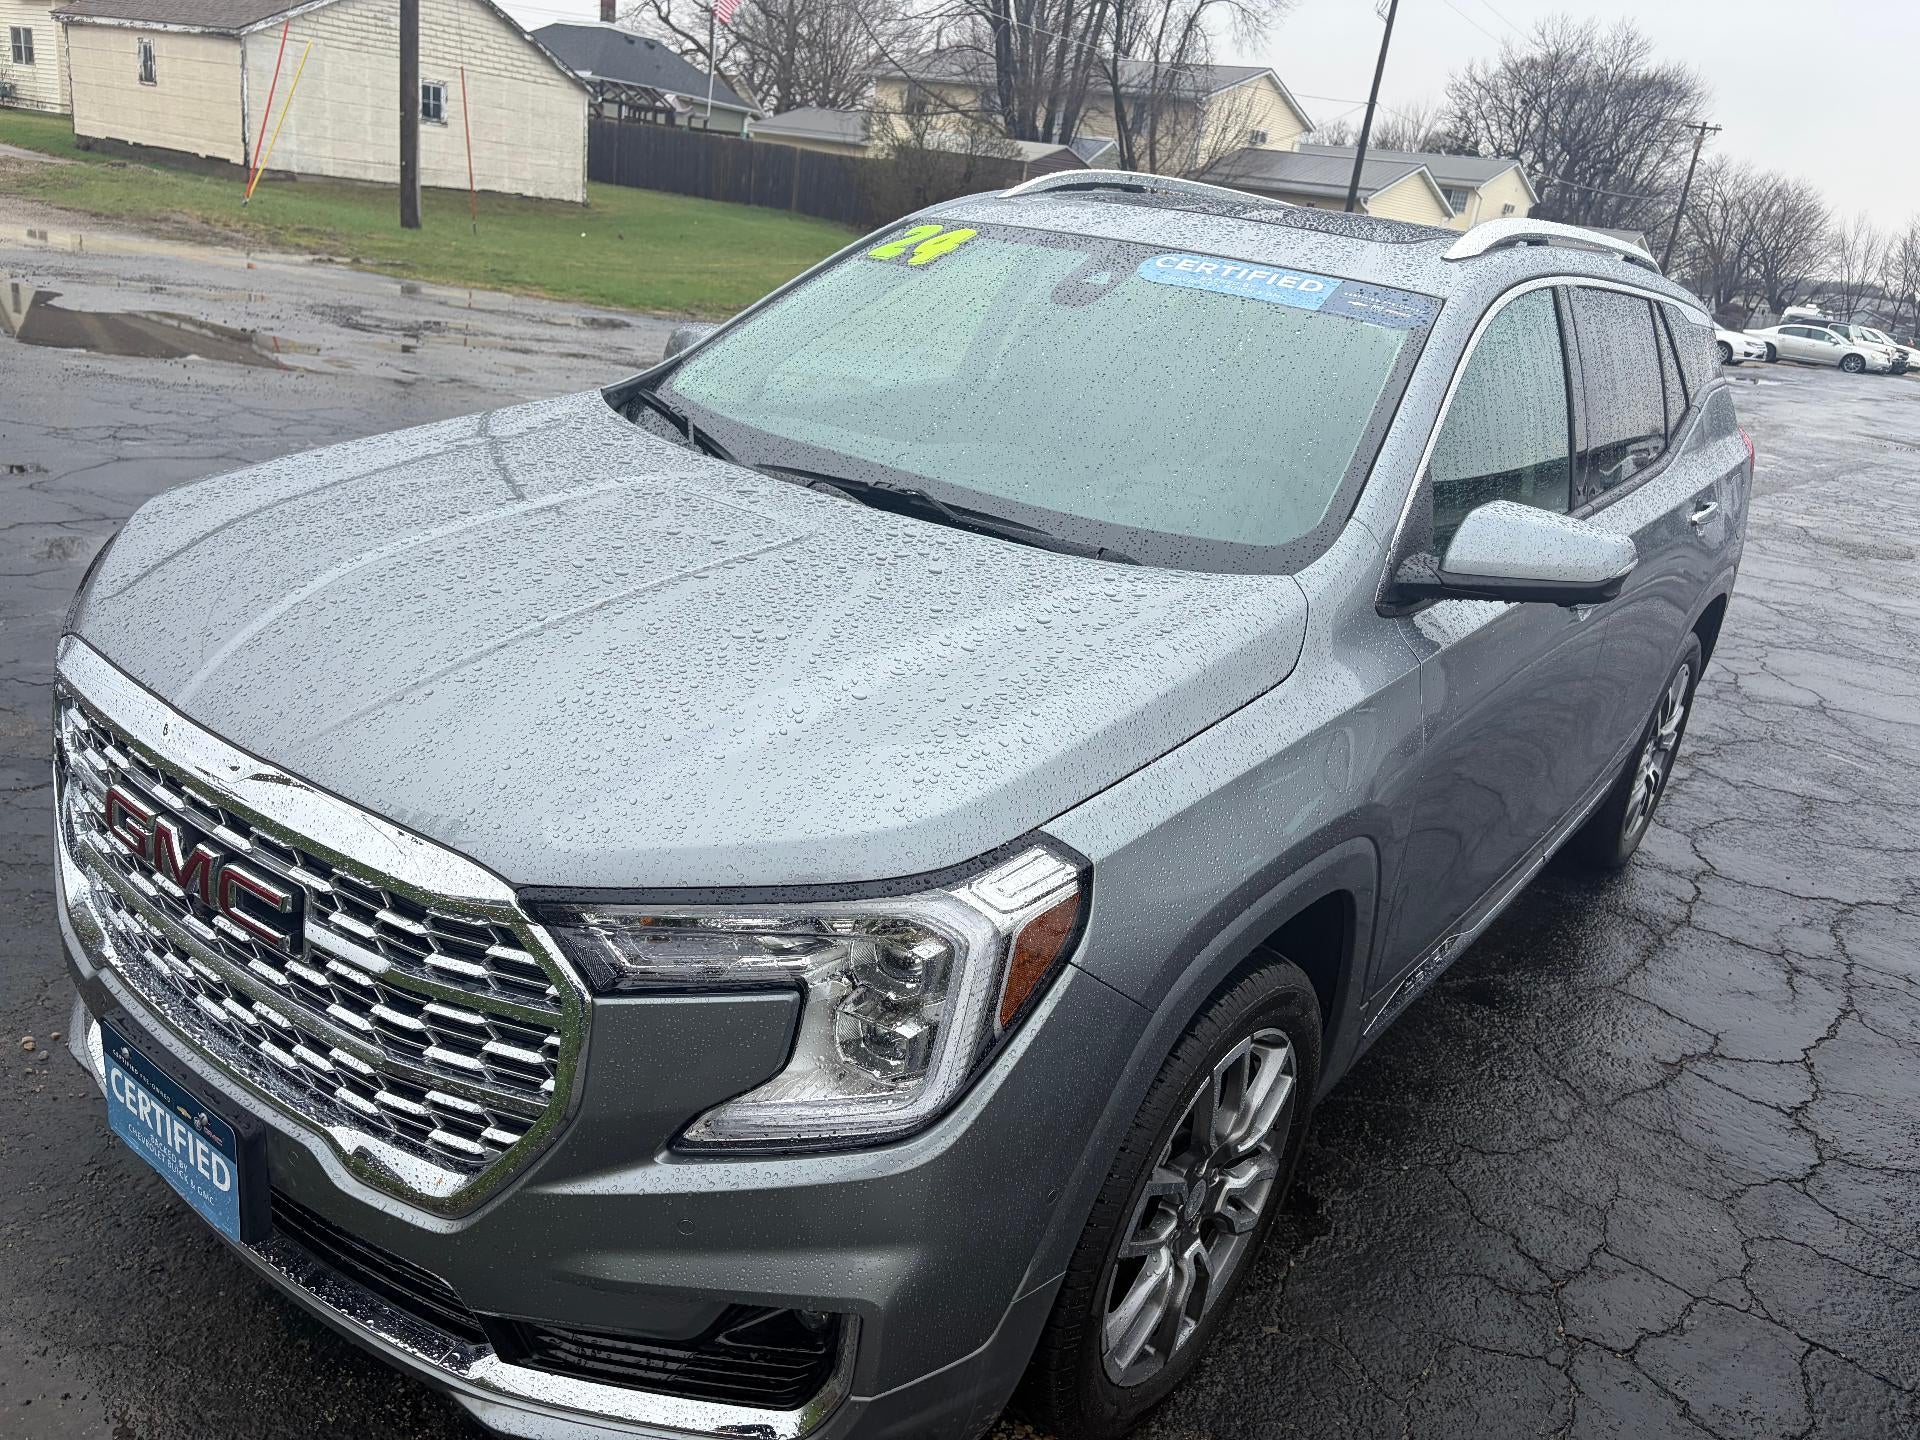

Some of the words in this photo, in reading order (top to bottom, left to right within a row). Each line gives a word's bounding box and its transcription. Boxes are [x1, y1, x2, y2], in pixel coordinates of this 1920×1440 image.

[1155, 256, 1324, 293] CERTIFIED
[106, 784, 292, 953] GMC
[111, 1067, 231, 1192] CERTIFIED
[150, 1134, 176, 1162] BACKED
[178, 1159, 188, 1172] BY
[167, 1158, 189, 1184] BUICK
[197, 1186, 215, 1206] GMC
